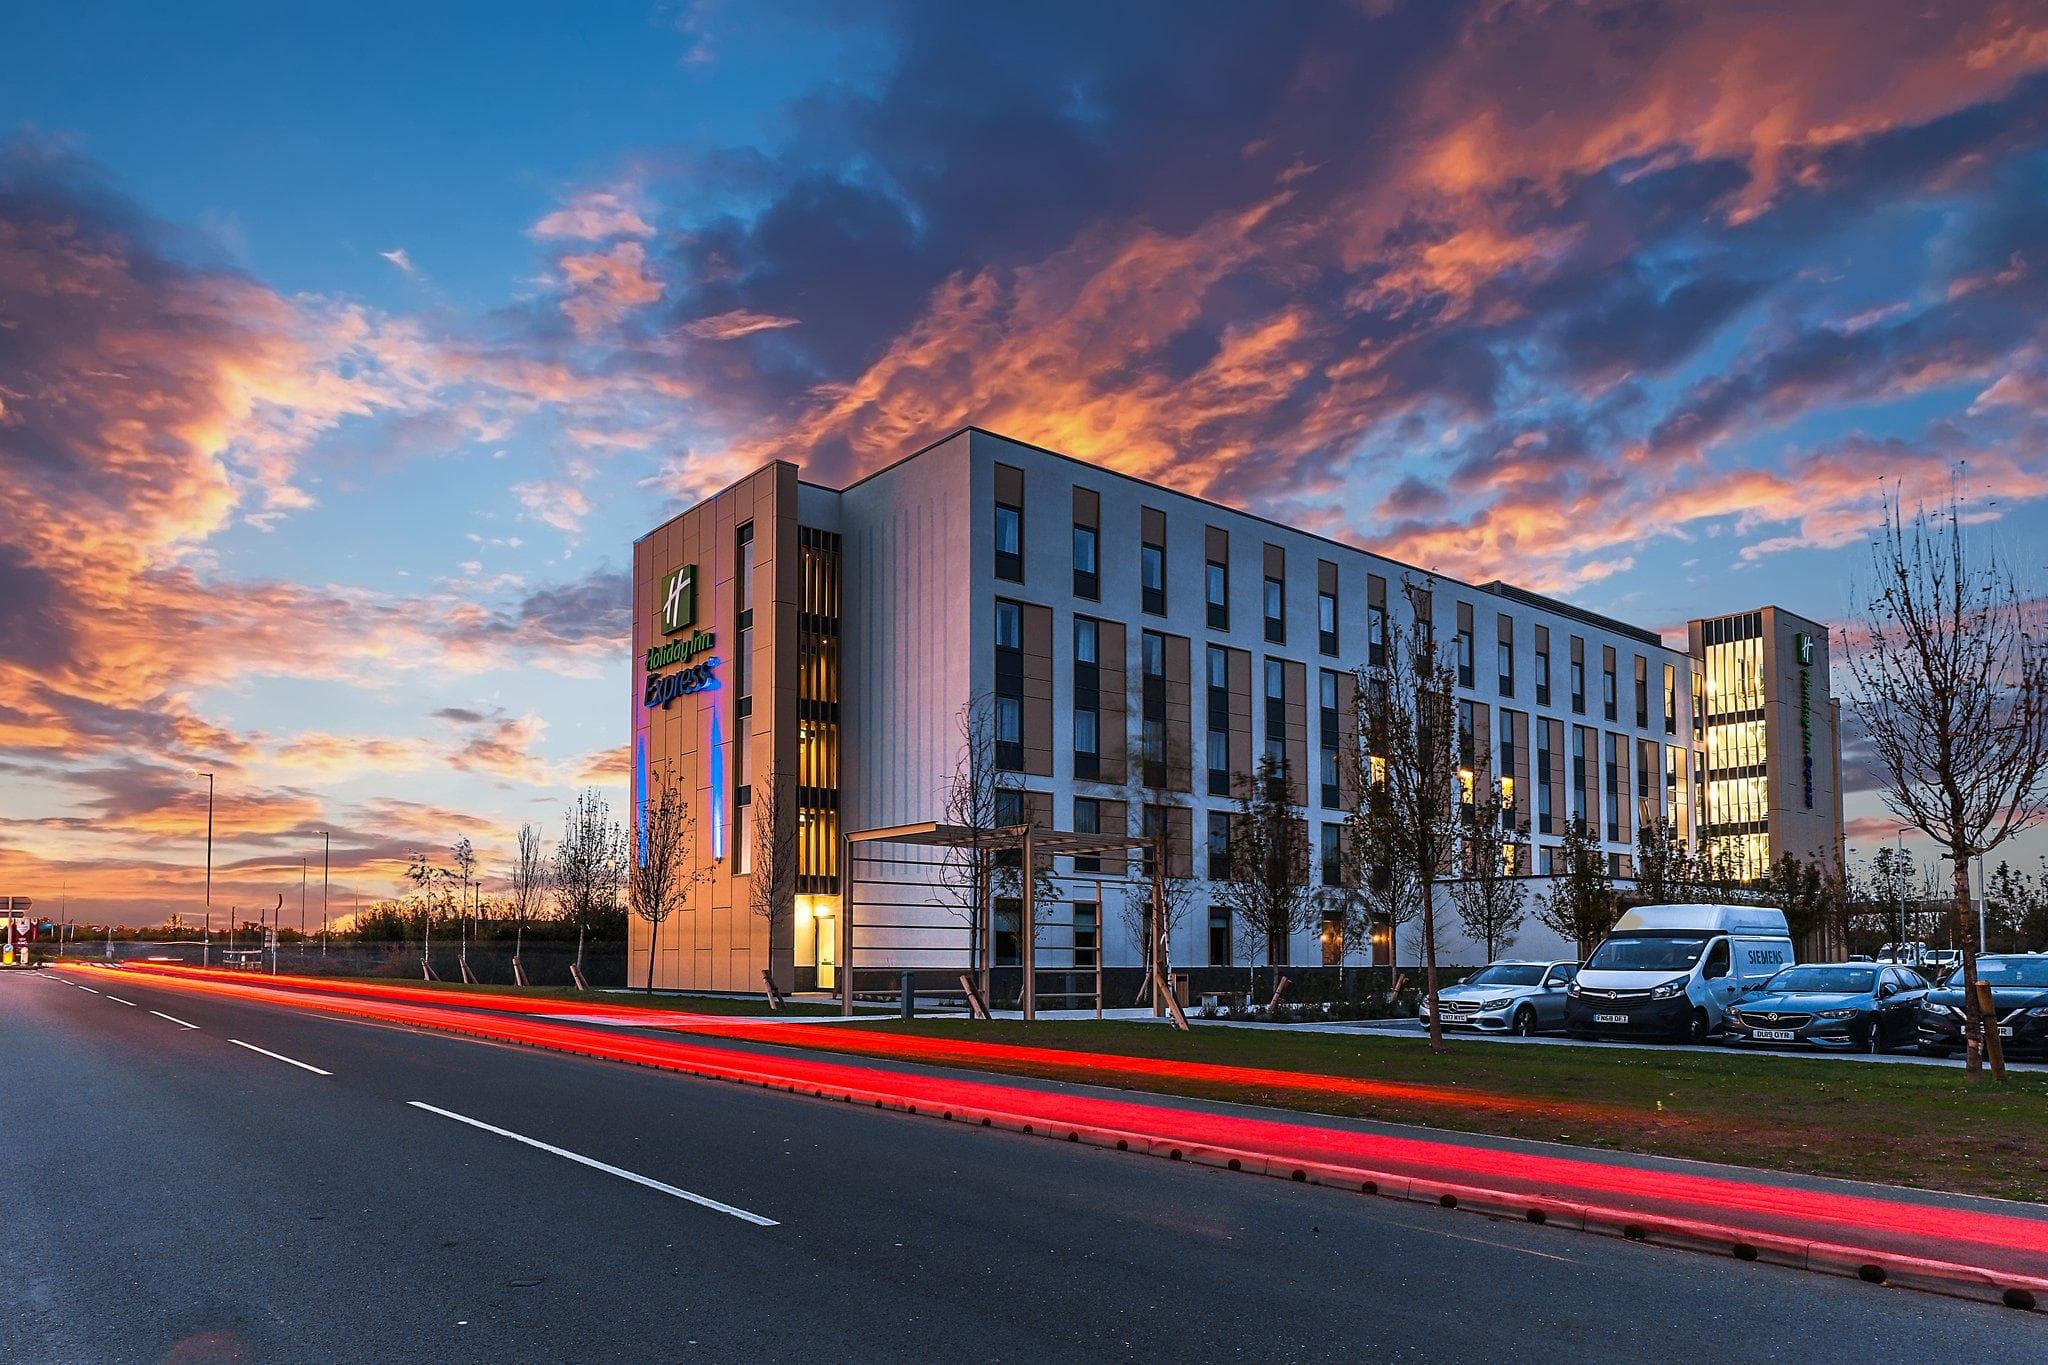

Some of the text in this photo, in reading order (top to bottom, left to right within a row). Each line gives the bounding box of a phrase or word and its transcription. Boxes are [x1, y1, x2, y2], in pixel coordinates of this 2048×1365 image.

[646, 630, 715, 671] Holiday Inn
[644, 661, 713, 709] Express
[1748, 950, 1783, 965] SIEMENS
